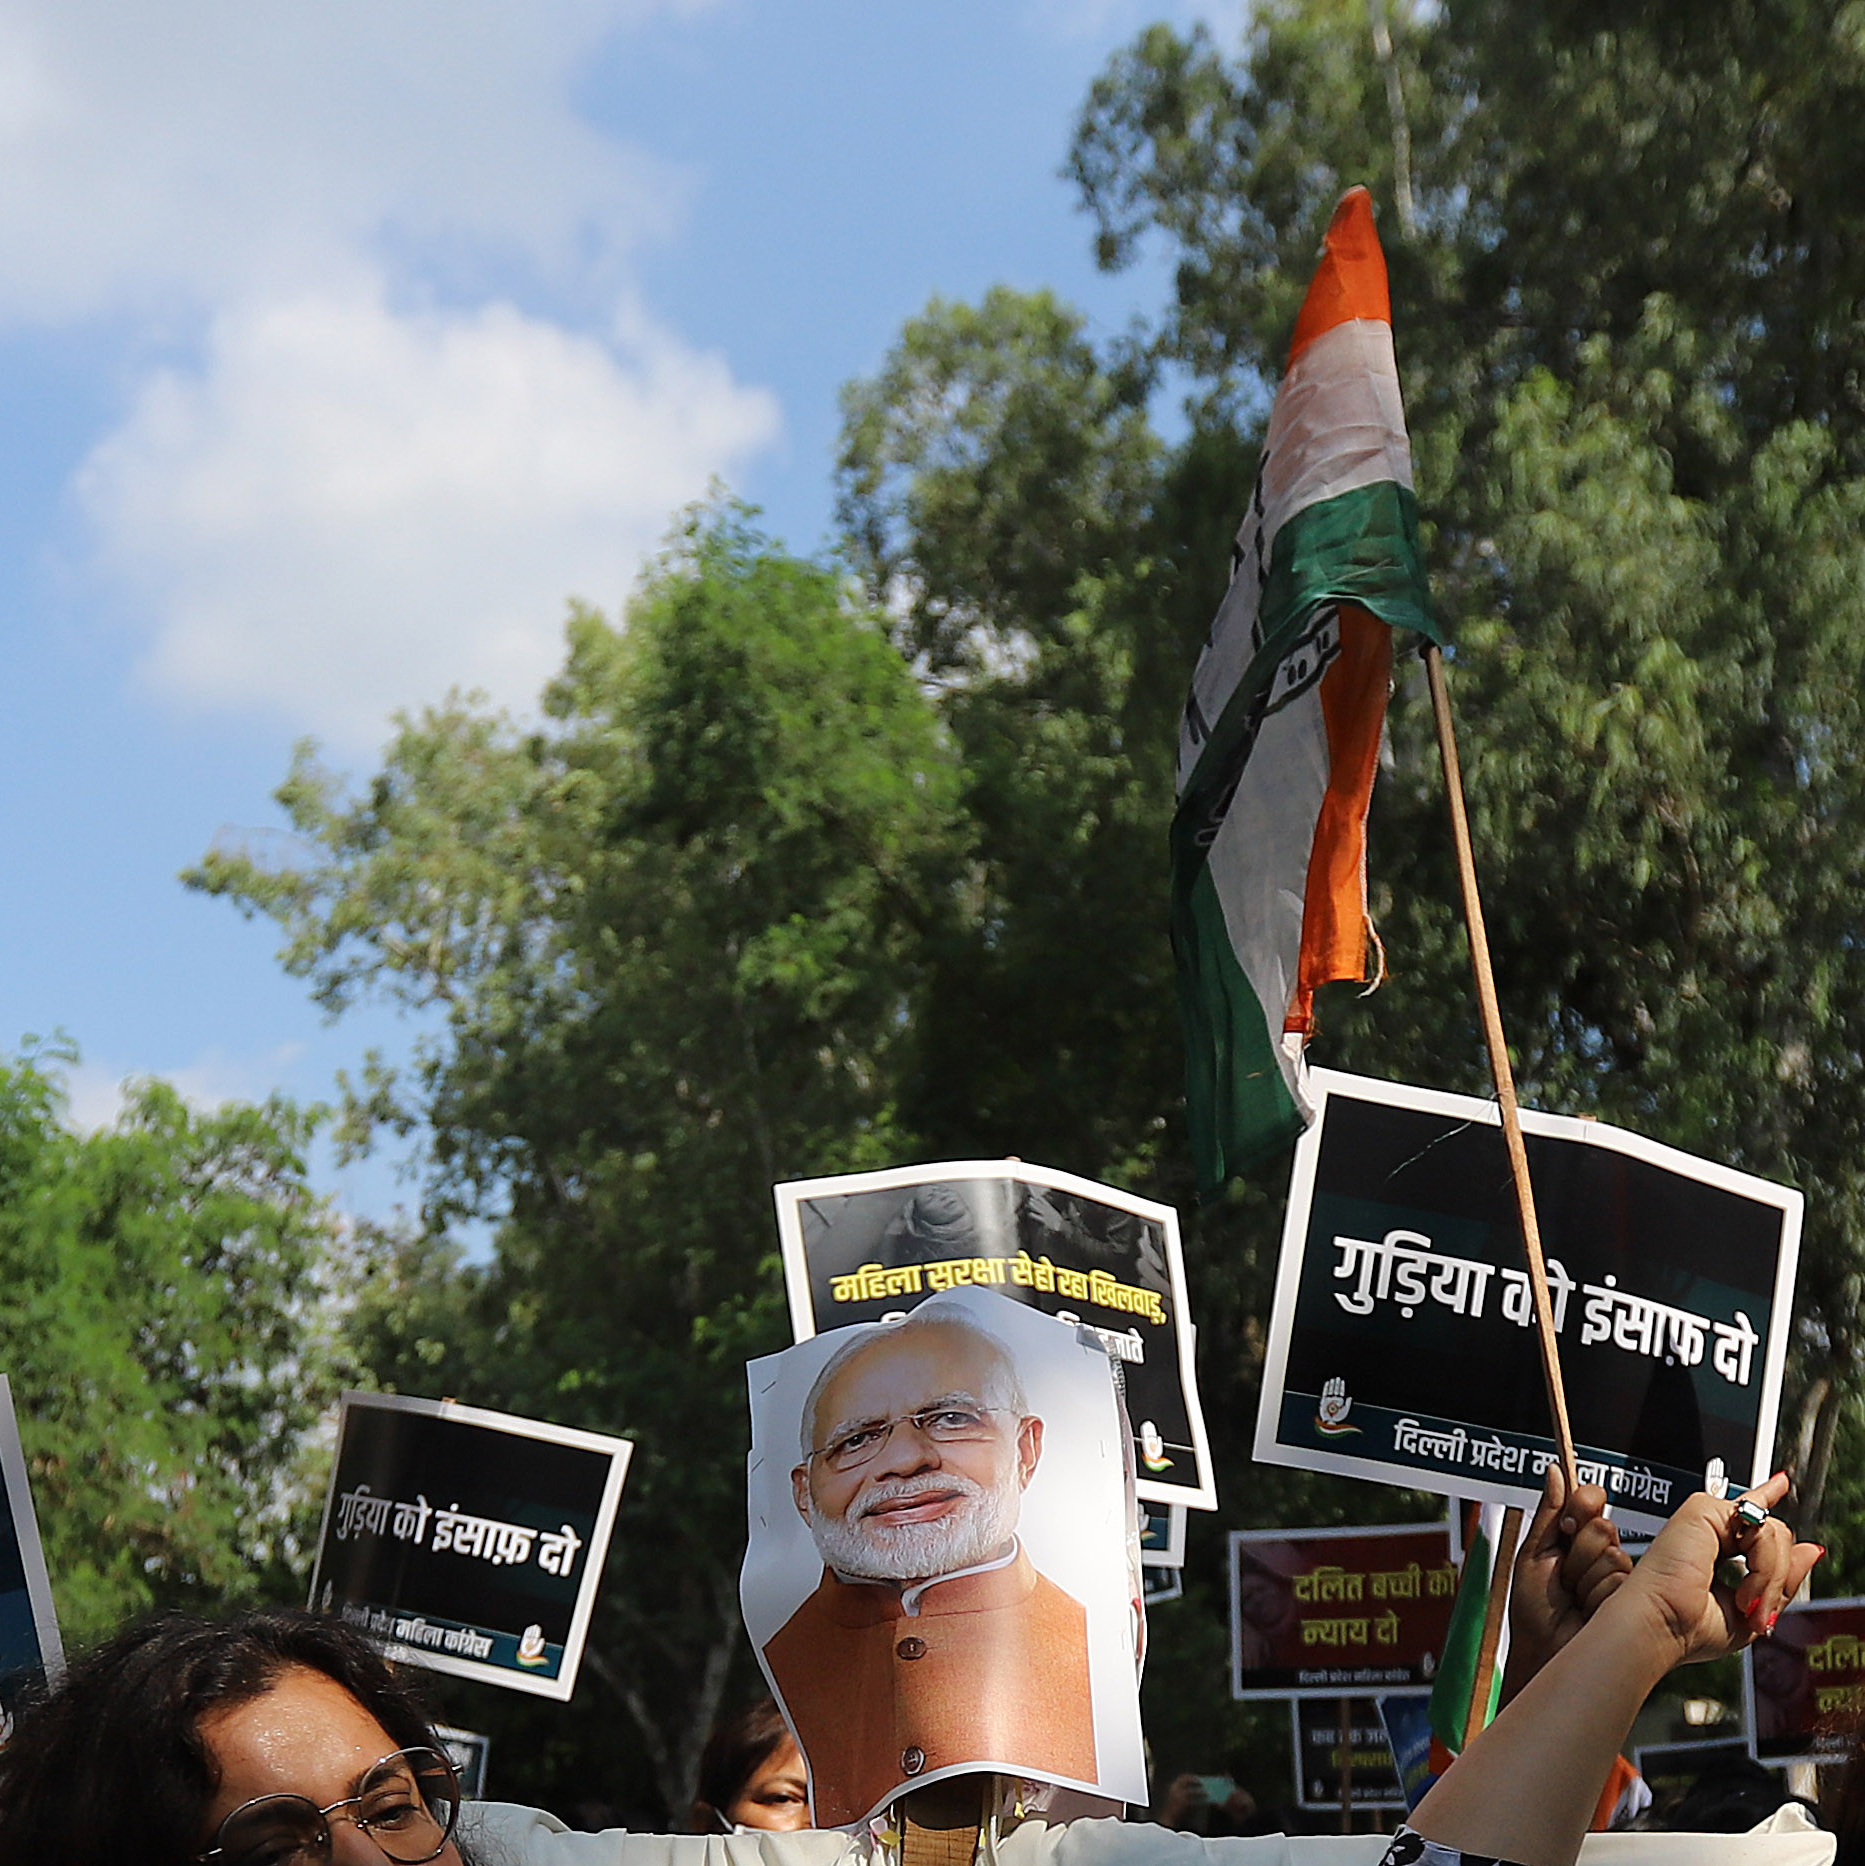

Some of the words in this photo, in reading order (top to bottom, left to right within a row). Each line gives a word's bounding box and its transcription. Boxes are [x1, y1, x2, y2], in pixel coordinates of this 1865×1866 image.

[829, 1263, 924, 1302] महिला
[1008, 1249, 1035, 1287] से
[1034, 1255, 1059, 1291] हो
[1057, 1267, 1089, 1300] रहा
[1333, 1228, 1495, 1320] गुड़िया
[1580, 1273, 1713, 1368] इंसाफ़
[1710, 1310, 1760, 1387] दो
[1392, 1417, 1468, 1462] दिल्ली
[1469, 1431, 1530, 1474] प्रदेश
[1610, 1460, 1673, 1505] कांग्रेस
[337, 1484, 394, 1541] गुड़िया
[392, 1495, 433, 1547] को
[432, 1503, 539, 1567] इंसाफ़
[537, 1525, 582, 1578] दो
[1293, 1566, 1366, 1602] दलित
[1369, 1562, 1426, 1600] बच्ची
[1426, 1562, 1458, 1598] को
[395, 1617, 444, 1648] महिला
[1301, 1618, 1372, 1648] न्याय
[1374, 1610, 1401, 1645] दो
